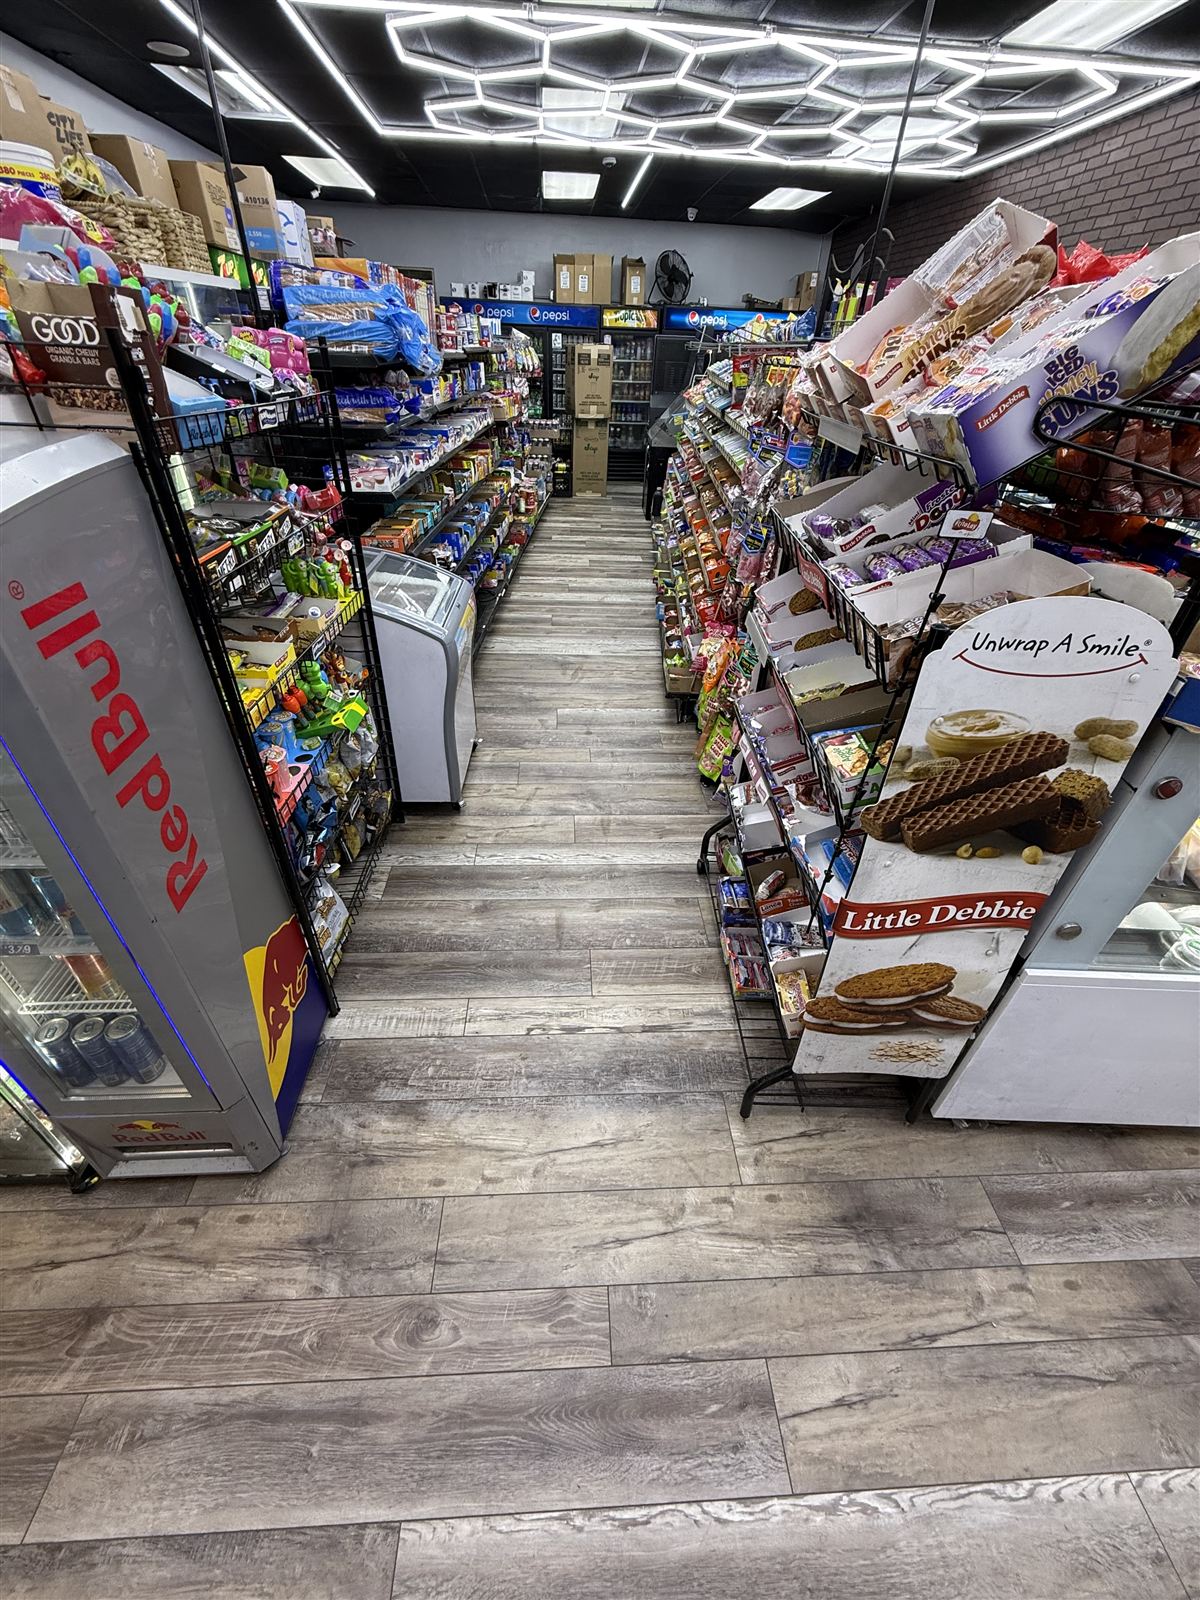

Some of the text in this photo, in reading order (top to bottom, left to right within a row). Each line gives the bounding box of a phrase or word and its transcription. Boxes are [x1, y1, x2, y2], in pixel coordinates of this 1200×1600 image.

[47, 111, 74, 130] CITY
[56, 127, 84, 146] LIFE
[486, 307, 515, 319] pepsi
[542, 310, 570, 322] pepsi
[701, 314, 728, 329] pepsi
[31, 315, 100, 346] GOOD
[45, 345, 99, 358] ORGANIC CHEWY
[50, 354, 101, 366] GRANOLA BARS
[1043, 344, 1080, 375] BIG
[1044, 354, 1086, 388] ICED
[976, 388, 1027, 430] Little Debbie
[972, 631, 1140, 658] Unwrap A Smile
[20, 581, 209, 914] Red Bull
[842, 900, 1037, 931] Little Debbie
[111, 1130, 208, 1143] Red Bull
